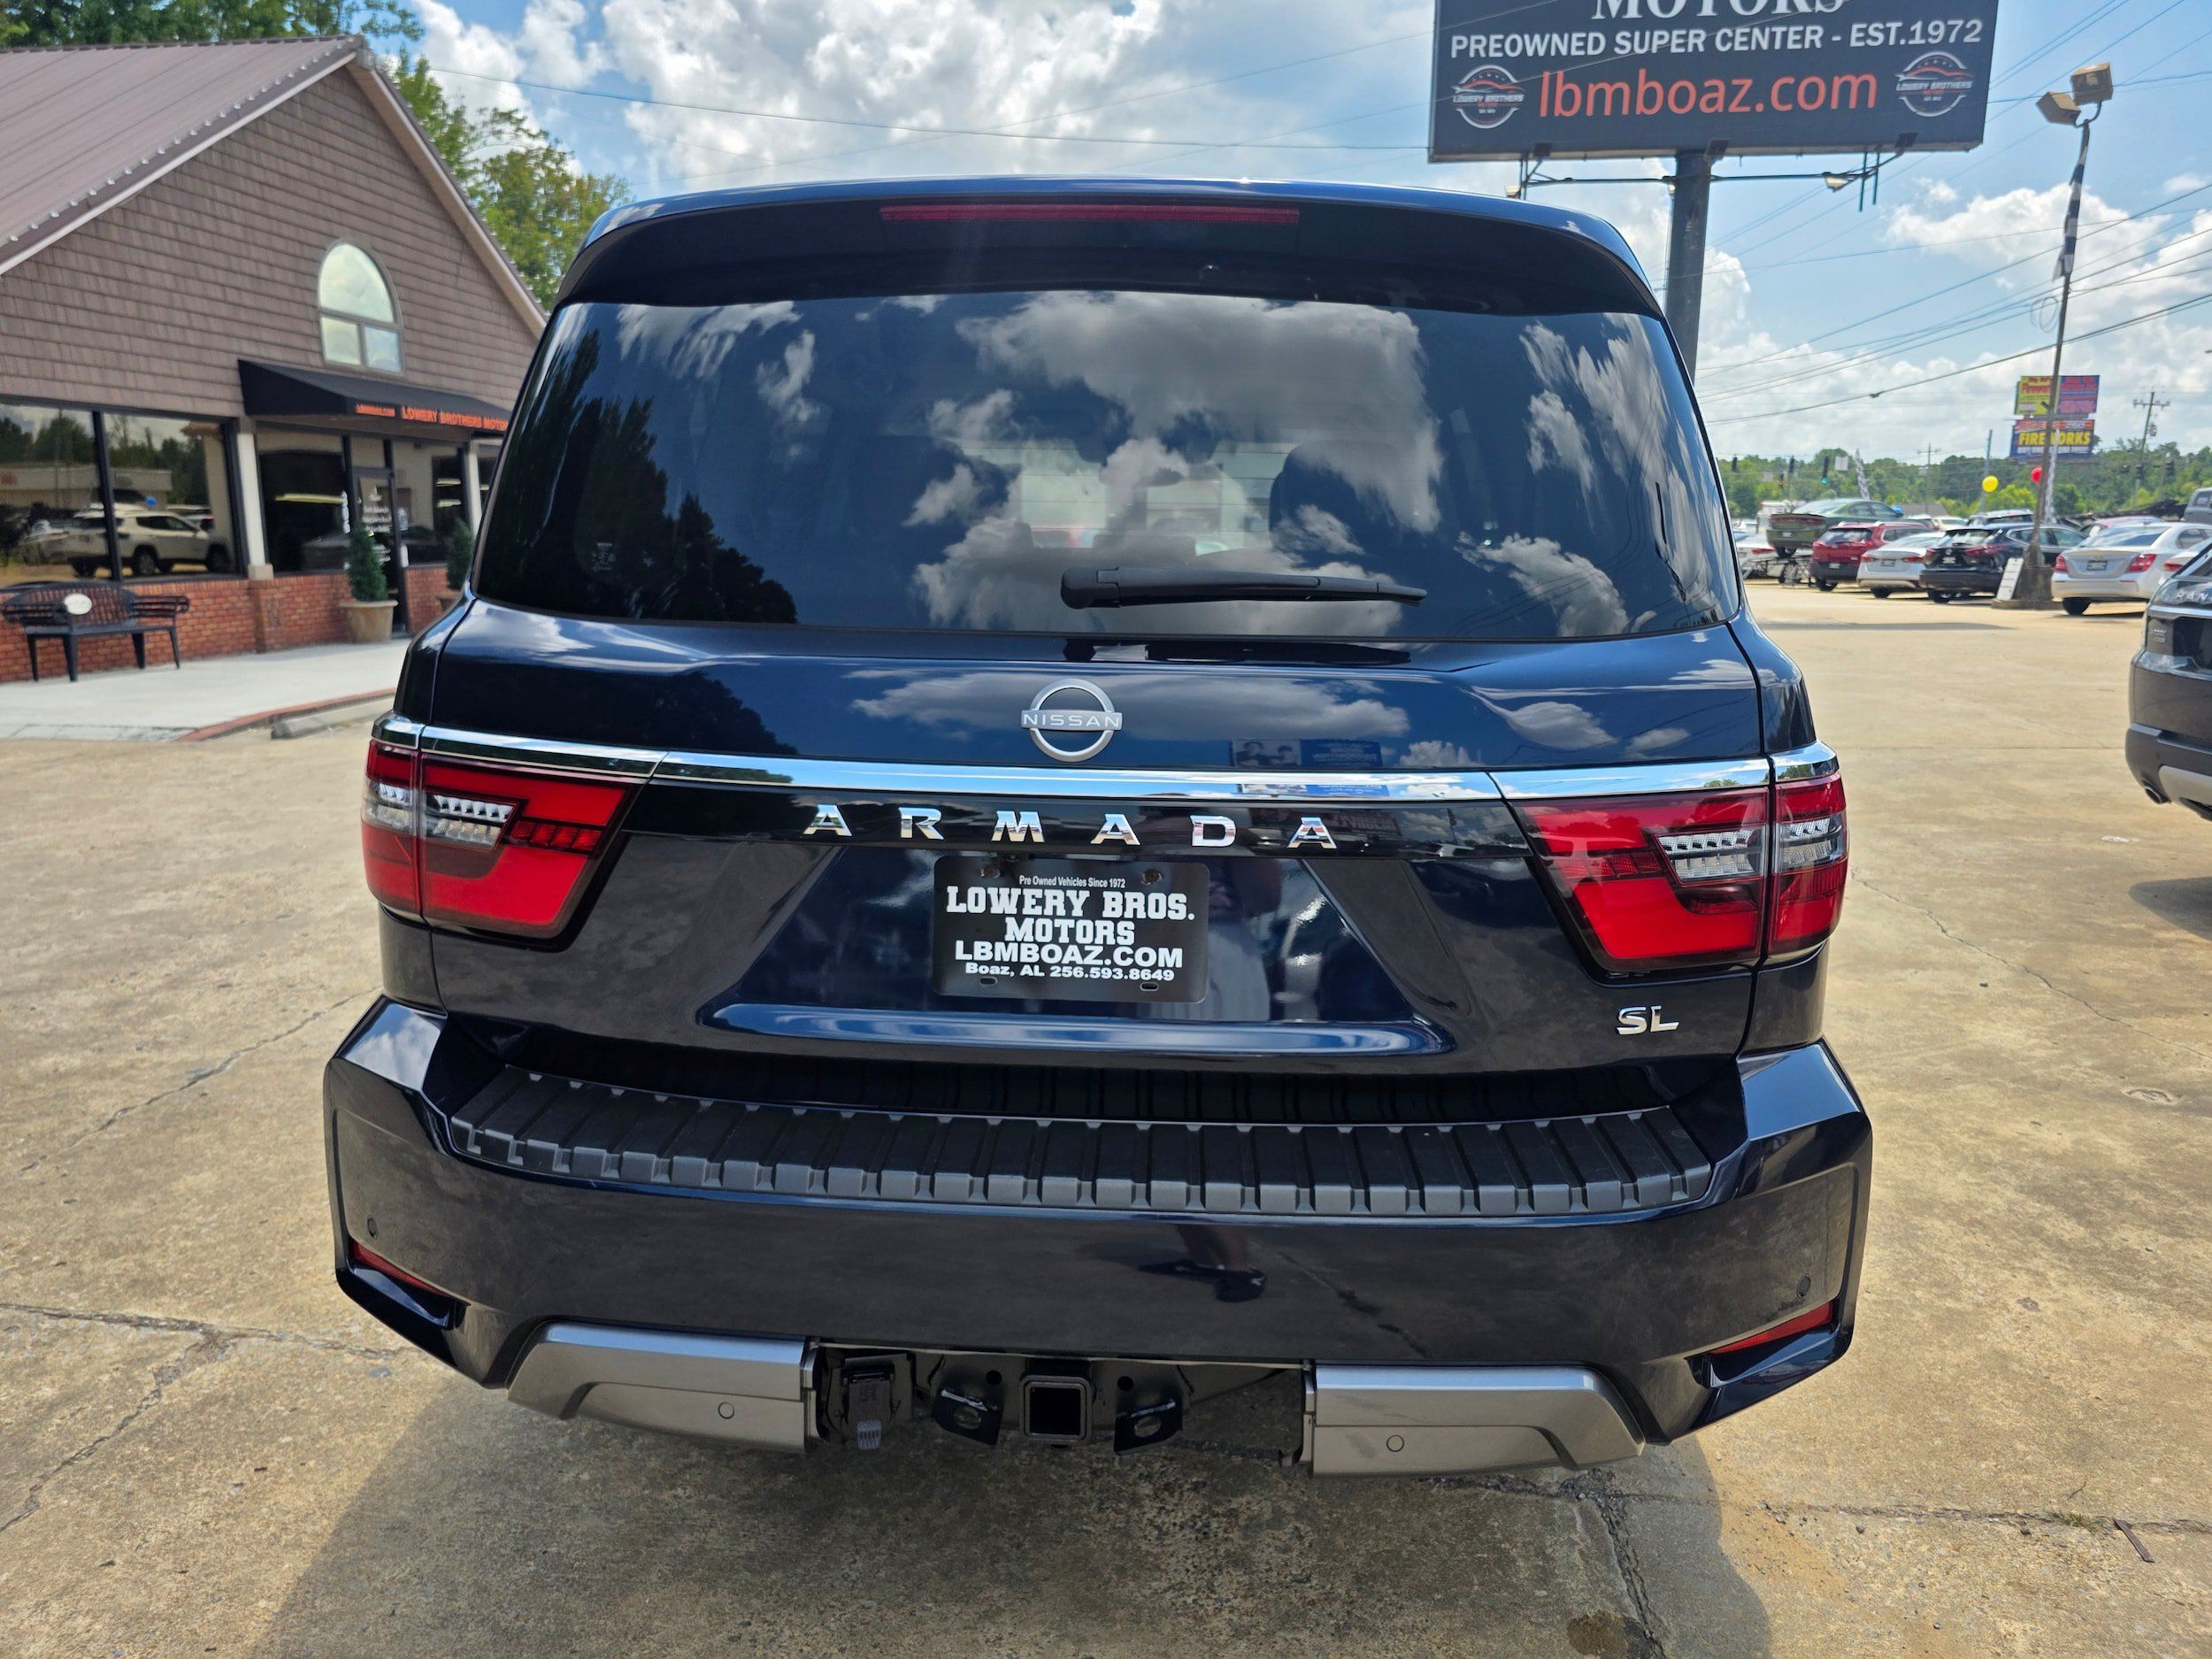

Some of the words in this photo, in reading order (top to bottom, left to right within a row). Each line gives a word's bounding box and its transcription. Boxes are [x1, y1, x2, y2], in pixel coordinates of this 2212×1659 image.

[1451, 32, 1606, 58] PREOWNED
[1613, 28, 1706, 55] SUPER
[1715, 25, 1824, 52] CENTER
[1849, 19, 1983, 47] EST.1972
[1540, 68, 1878, 118] lbmboaz.com
[1023, 712, 1119, 727] NISSAN
[803, 803, 1338, 850] ARMADA
[1018, 874, 1032, 885] Pre
[1033, 875, 1056, 886] Owned
[1058, 876, 1087, 887] Vehicles
[1087, 877, 1108, 887] Since
[1109, 878, 1126, 888] 1972
[946, 885, 1090, 918] LOWERY
[1102, 890, 1195, 921] BROS.
[1004, 917, 1135, 946] MOTORS
[955, 940, 1184, 968] LBMBOAZ.COM
[965, 962, 1015, 978] Boaz,
[1020, 964, 1045, 977] AL
[1049, 965, 1175, 982] 256.593.8649
[1617, 1005, 1679, 1035] SL
